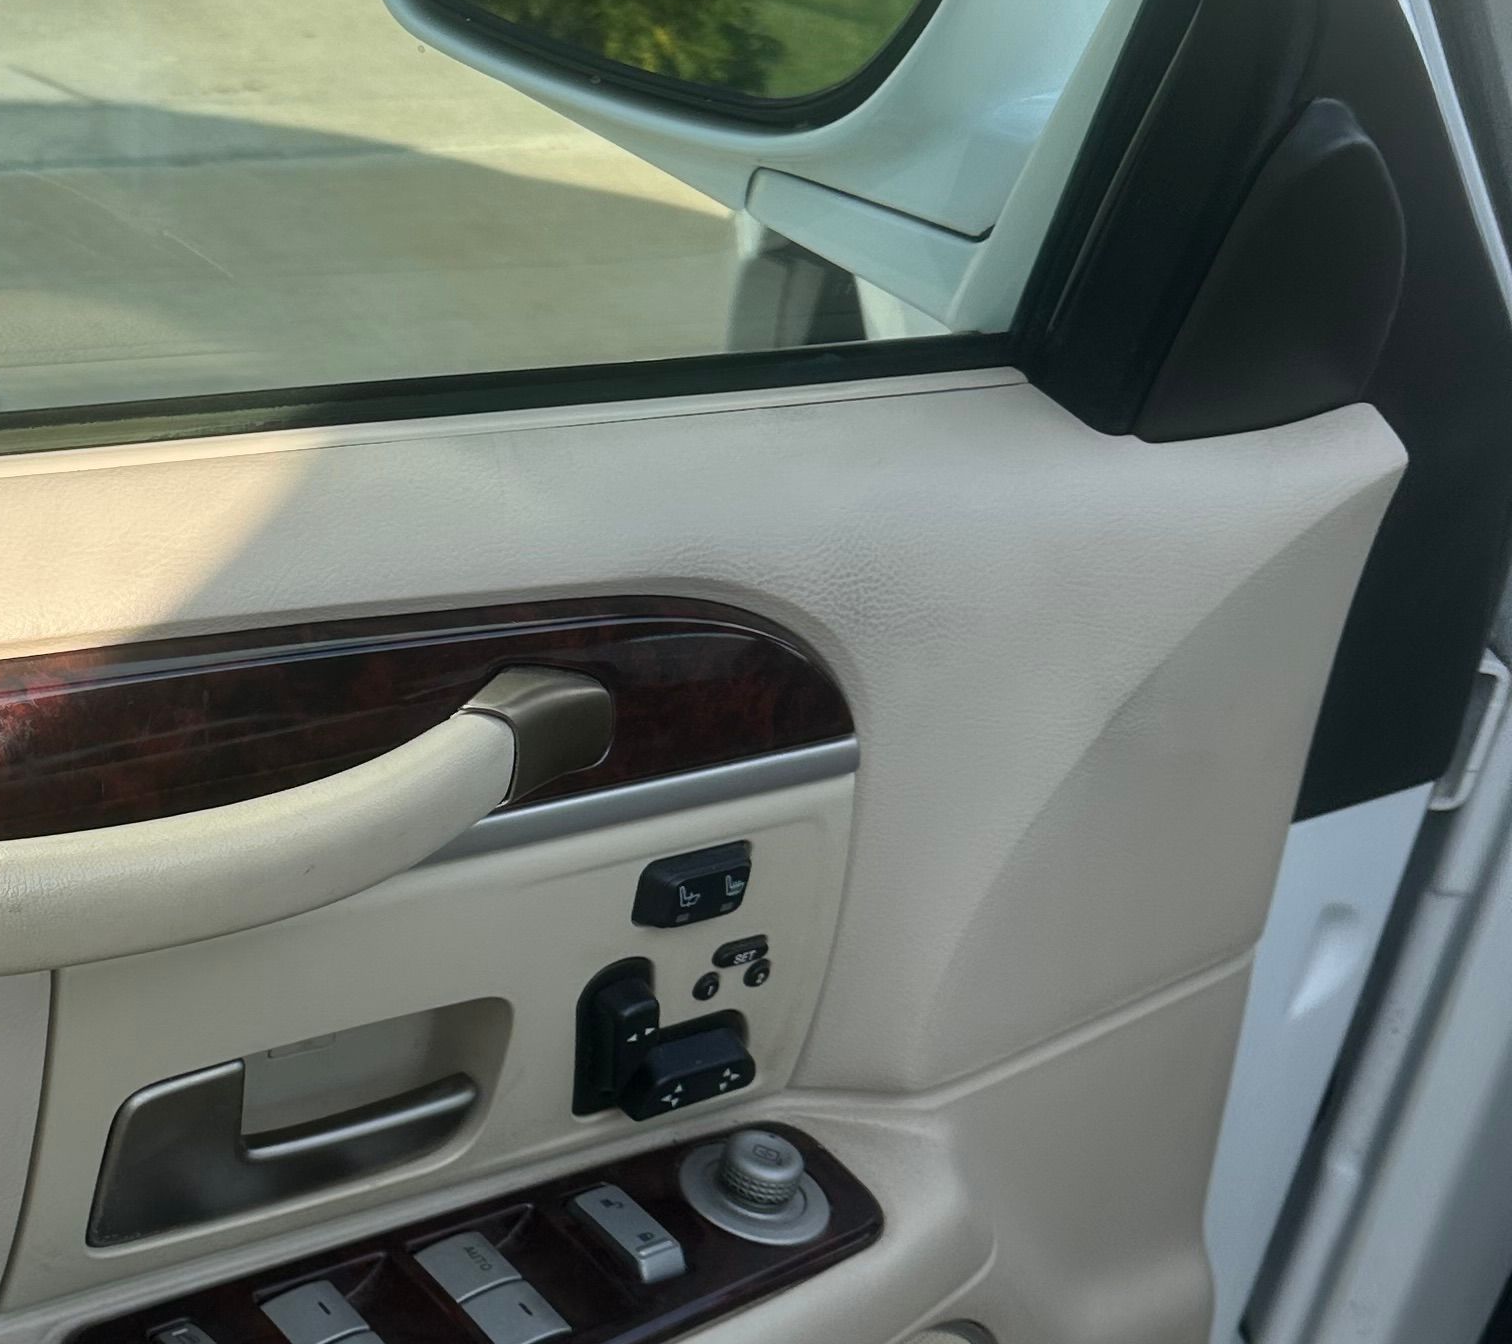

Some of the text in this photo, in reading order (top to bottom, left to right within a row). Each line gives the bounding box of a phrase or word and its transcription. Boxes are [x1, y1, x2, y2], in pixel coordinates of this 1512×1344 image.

[733, 949, 757, 964] SET
[755, 972, 765, 984] 2
[463, 1246, 493, 1271] AUTO
